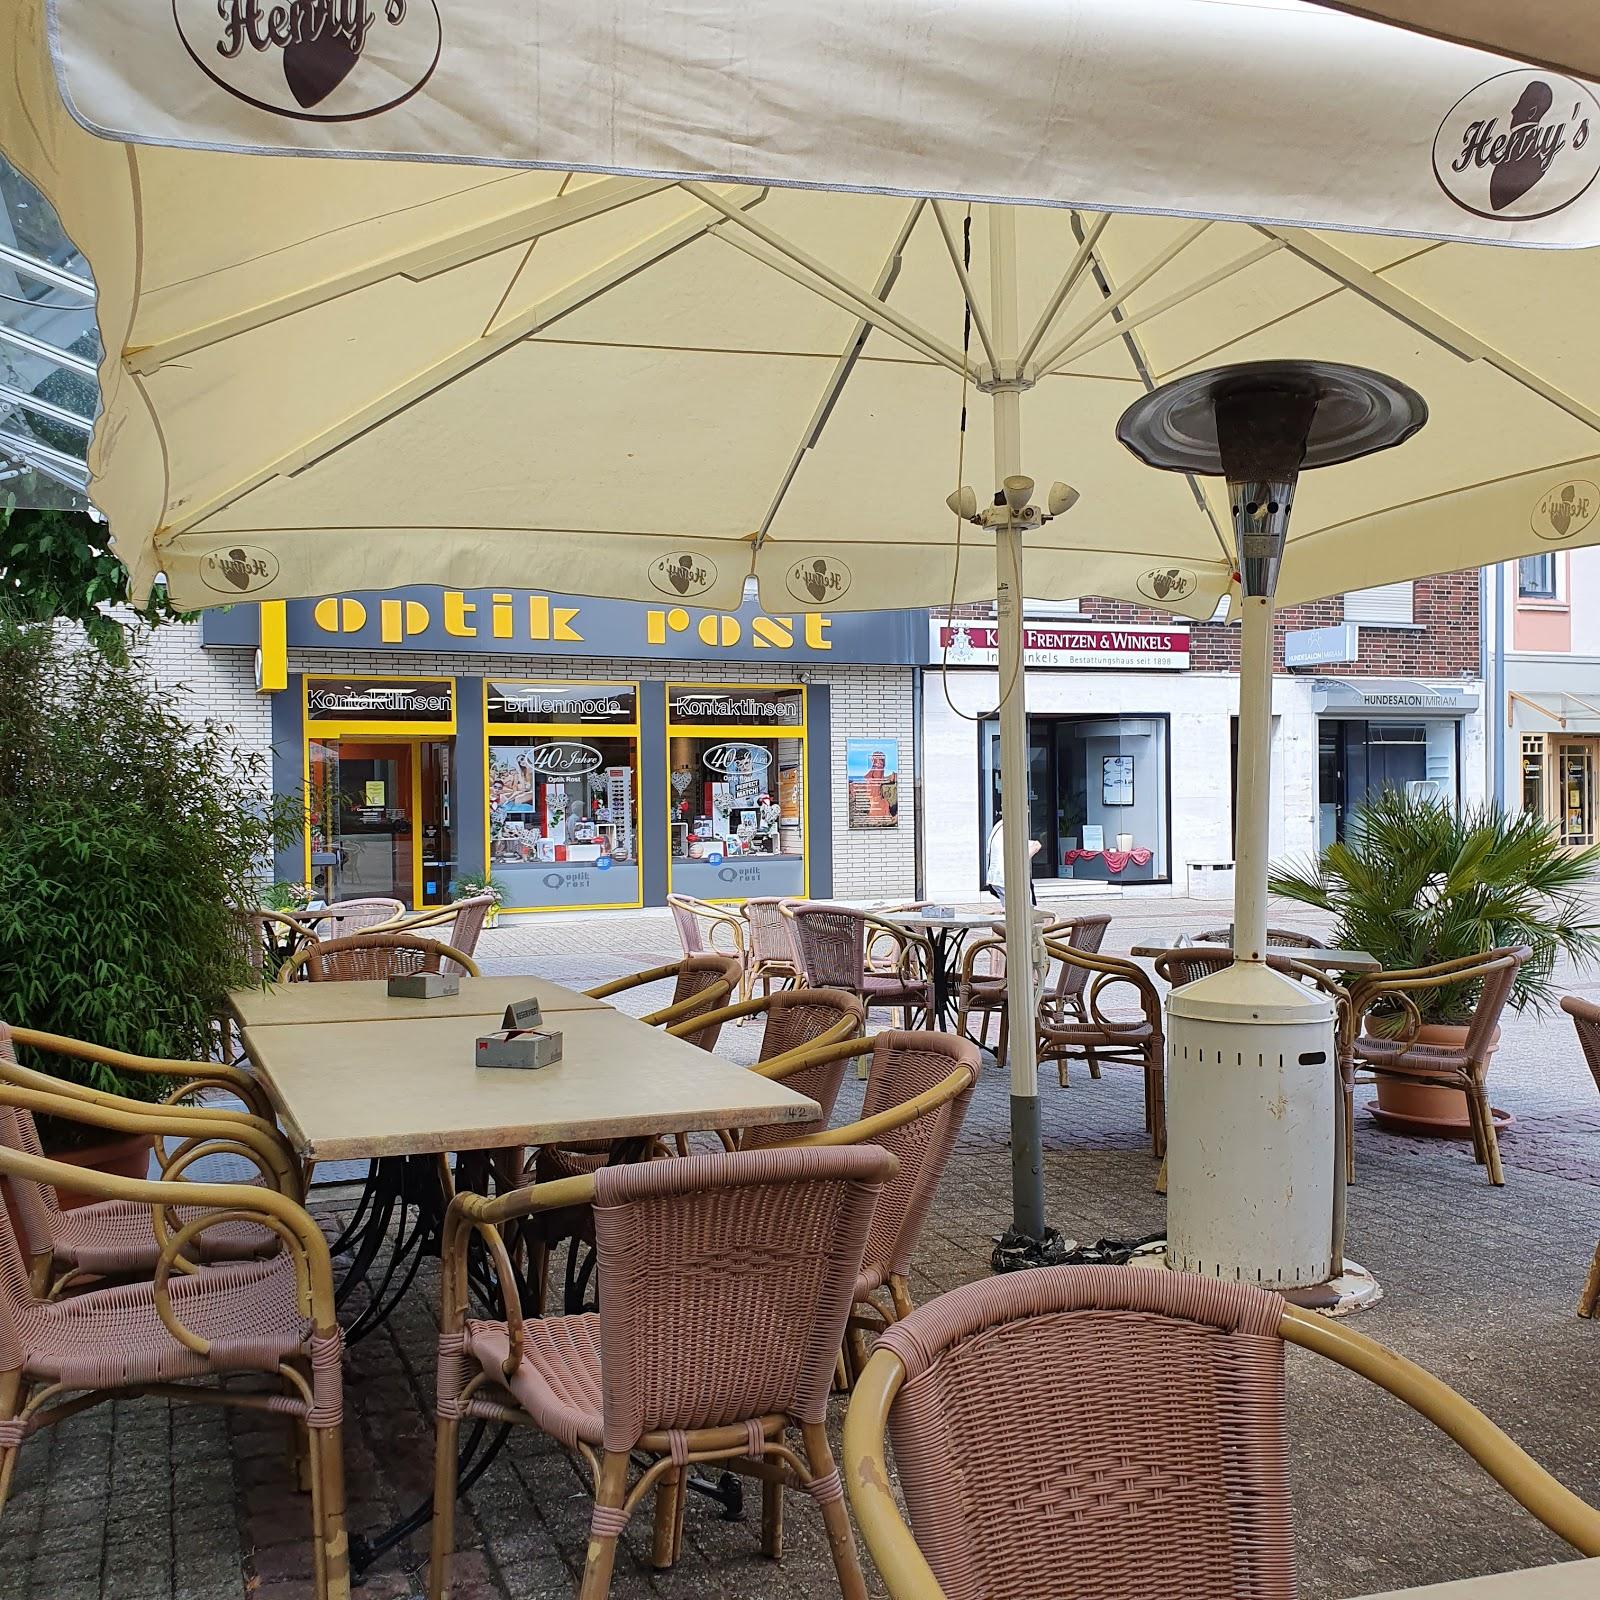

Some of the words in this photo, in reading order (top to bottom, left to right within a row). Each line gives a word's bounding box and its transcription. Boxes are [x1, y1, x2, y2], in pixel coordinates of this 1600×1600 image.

[216, 0, 407, 58] Henrys
[1451, 102, 1590, 173] Henry's
[314, 591, 585, 643] optik
[647, 608, 833, 650] rost
[1027, 630, 1097, 649] FRENTZEN
[1100, 635, 1110, 649] &
[1111, 632, 1172, 650] WINKELS
[1022, 650, 1059, 664] inkels
[1069, 655, 1134, 666] Bestattungshaus
[1136, 657, 1151, 665] seit
[1153, 657, 1171, 666] 1898
[308, 689, 452, 711] Kontaktlinsen
[504, 694, 621, 714] Brillenmode
[676, 697, 797, 716] Kontaktlinsen
[534, 747, 563, 769] 40
[559, 750, 598, 769] Jahre
[711, 748, 737, 768] 40
[548, 776, 565, 784] Optik
[736, 780, 759, 791] PERFECT
[736, 788, 759, 798] MATCH!
[566, 872, 590, 881] optik
[740, 867, 760, 875] optik
[788, 1107, 808, 1118] 42
